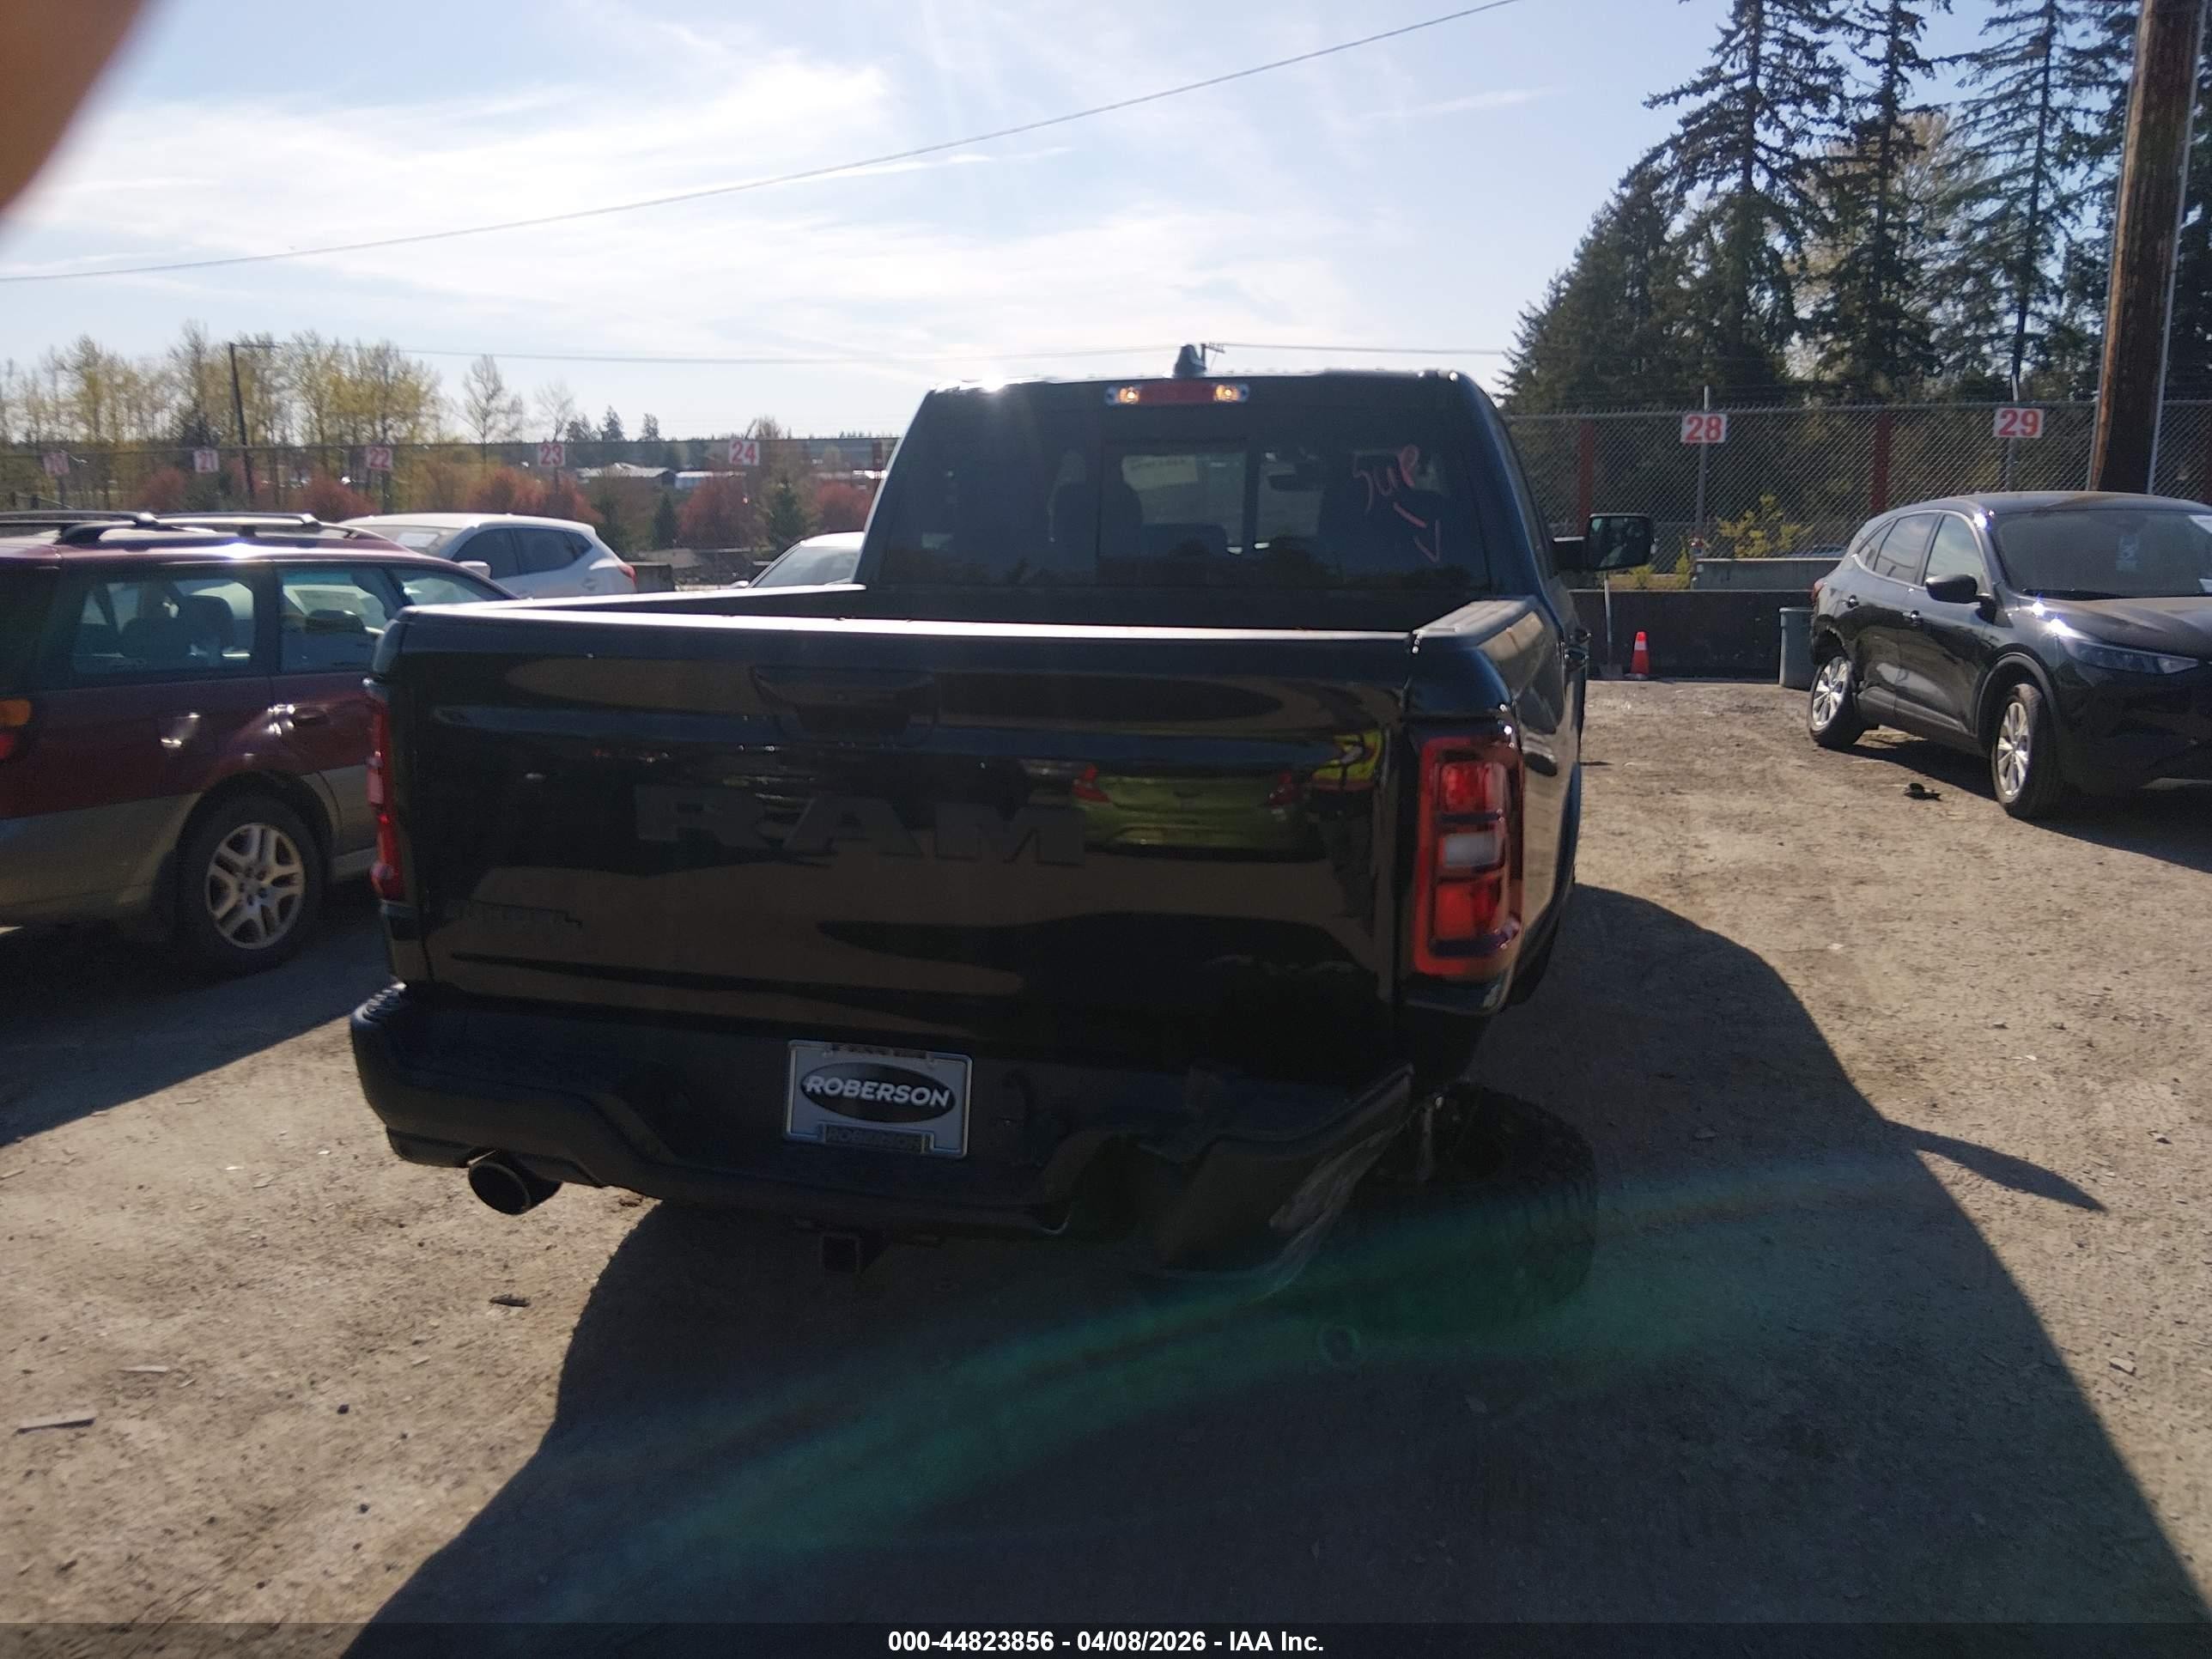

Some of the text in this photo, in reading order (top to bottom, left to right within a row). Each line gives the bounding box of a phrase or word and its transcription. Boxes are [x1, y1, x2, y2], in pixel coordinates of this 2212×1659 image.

[1686, 416, 1723, 441] 28
[1998, 410, 2039, 437] 29
[369, 447, 390, 469] 22
[539, 444, 563, 465] 23
[732, 441, 756, 465] 24
[633, 783, 1085, 867] RAM
[804, 1075, 951, 1108] ROBERSON
